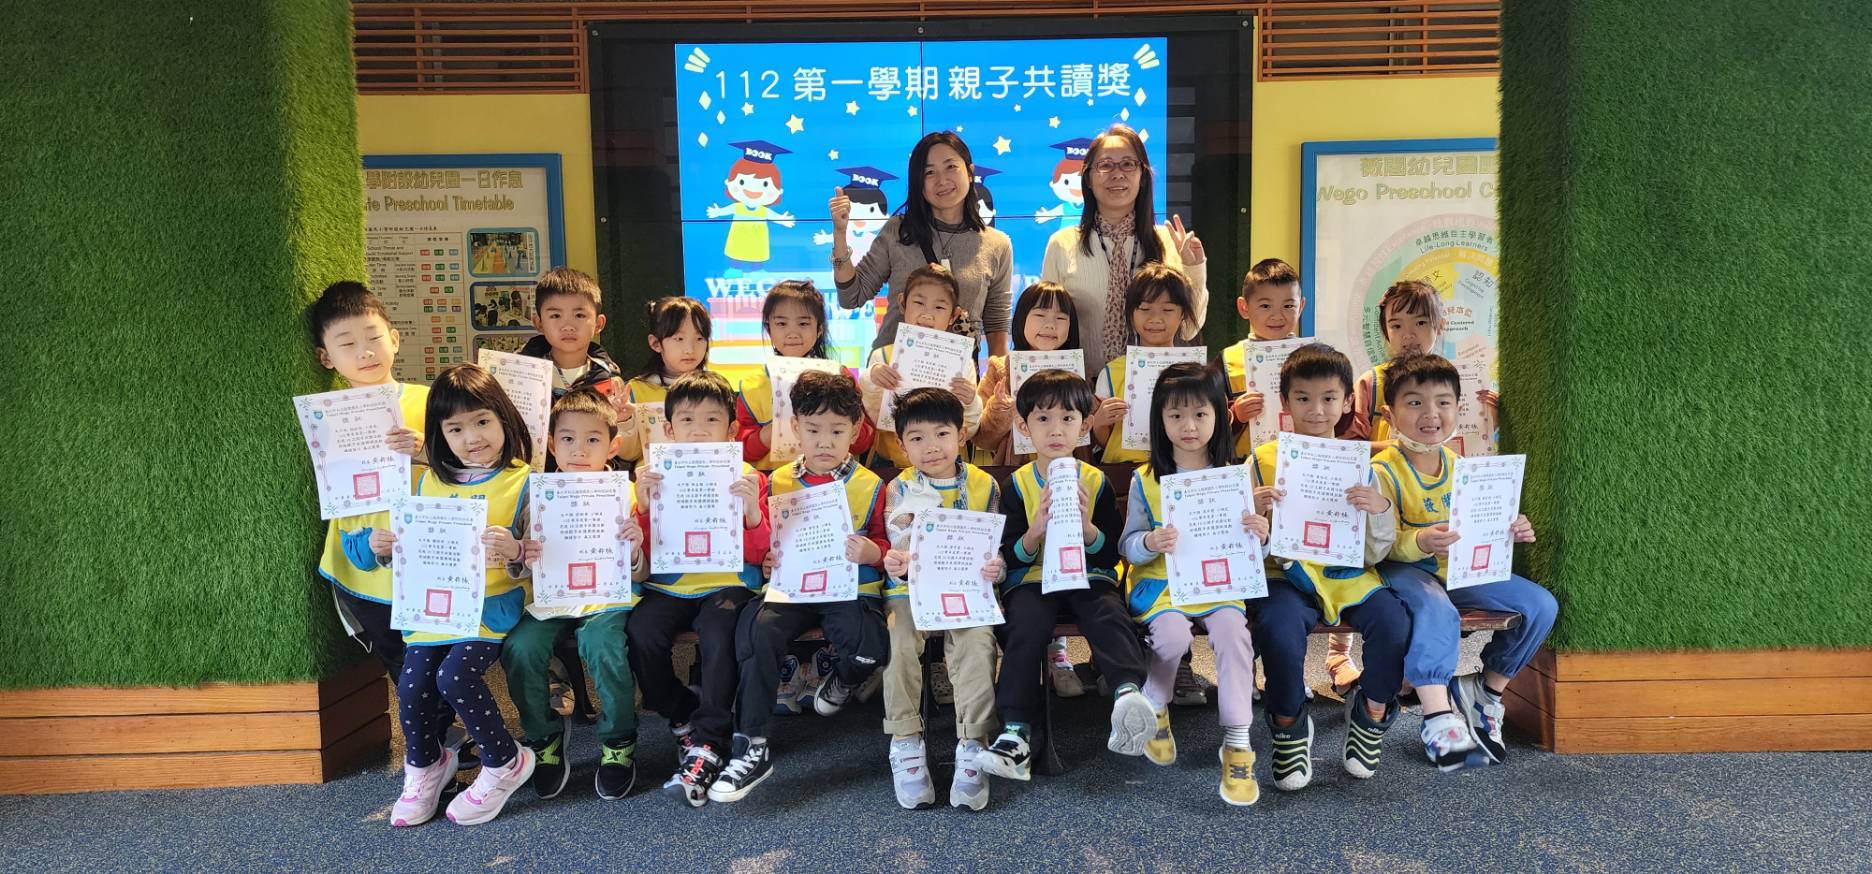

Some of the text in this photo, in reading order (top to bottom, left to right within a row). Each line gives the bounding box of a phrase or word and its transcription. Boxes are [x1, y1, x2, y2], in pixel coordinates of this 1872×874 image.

[716, 63, 1131, 101] 112 第一學期 親子共讀獎
[745, 148, 773, 161] BOOK
[1066, 147, 1090, 156] BOO
[852, 174, 879, 187] BOOK
[1376, 182, 1473, 200] Preschool
[385, 195, 449, 212] Preschool
[452, 194, 515, 212] Timetable
